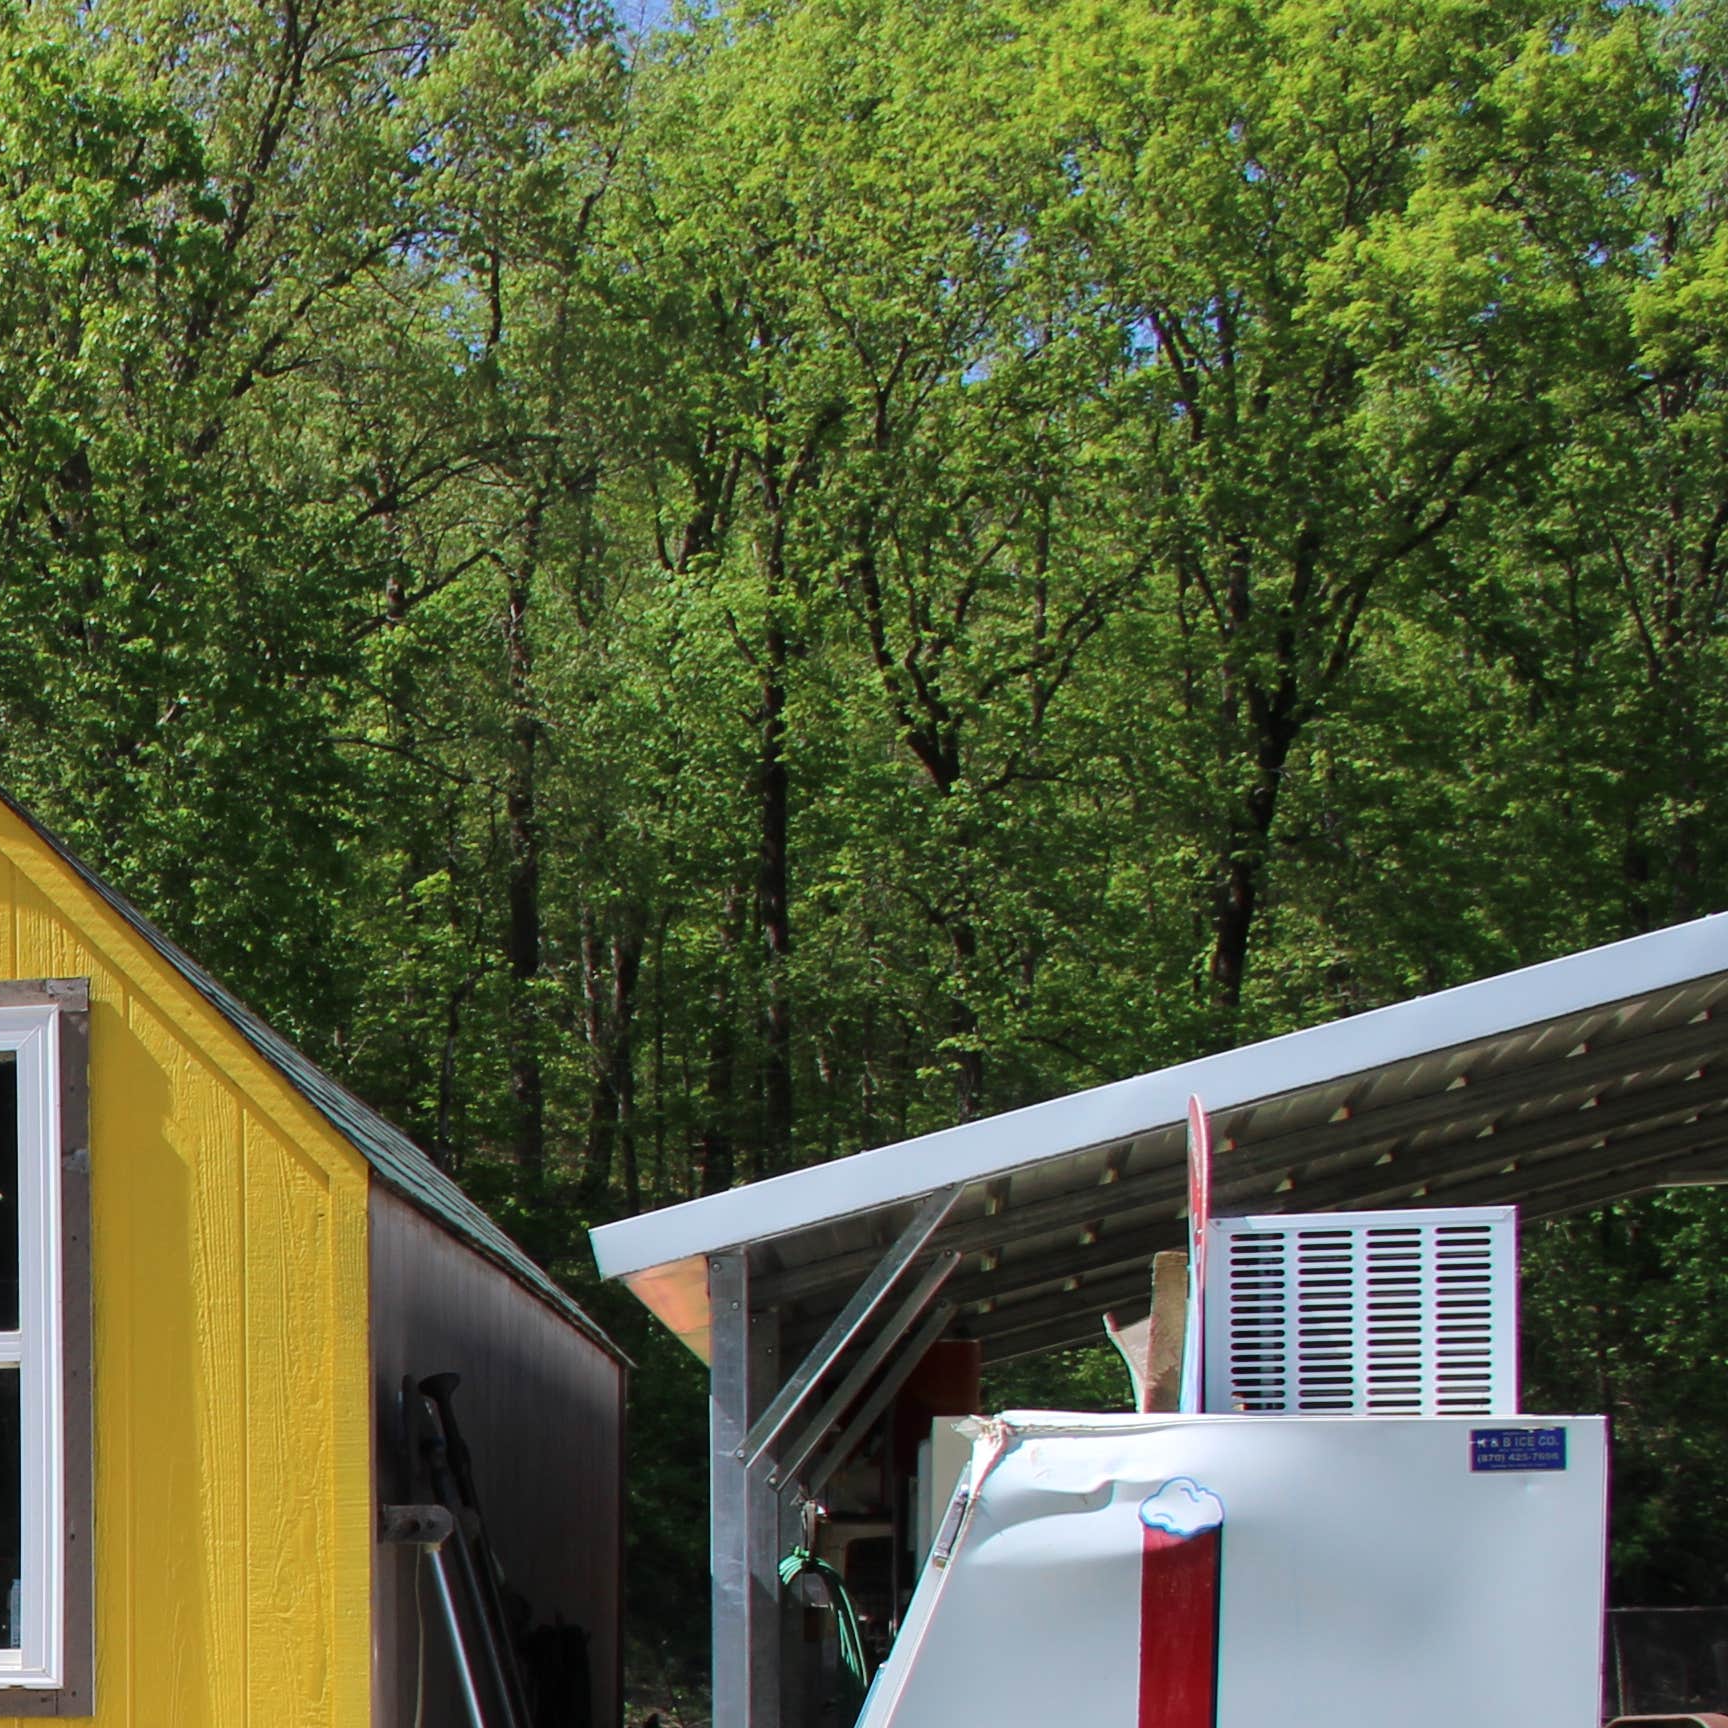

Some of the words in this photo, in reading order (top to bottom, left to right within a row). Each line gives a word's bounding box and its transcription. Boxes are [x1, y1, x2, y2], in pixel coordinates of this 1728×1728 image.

[1490, 1437, 1499, 1447] &
[1503, 1436, 1511, 1447] B
[1514, 1436, 1535, 1447] ICE
[1538, 1435, 1560, 1447] CO.
